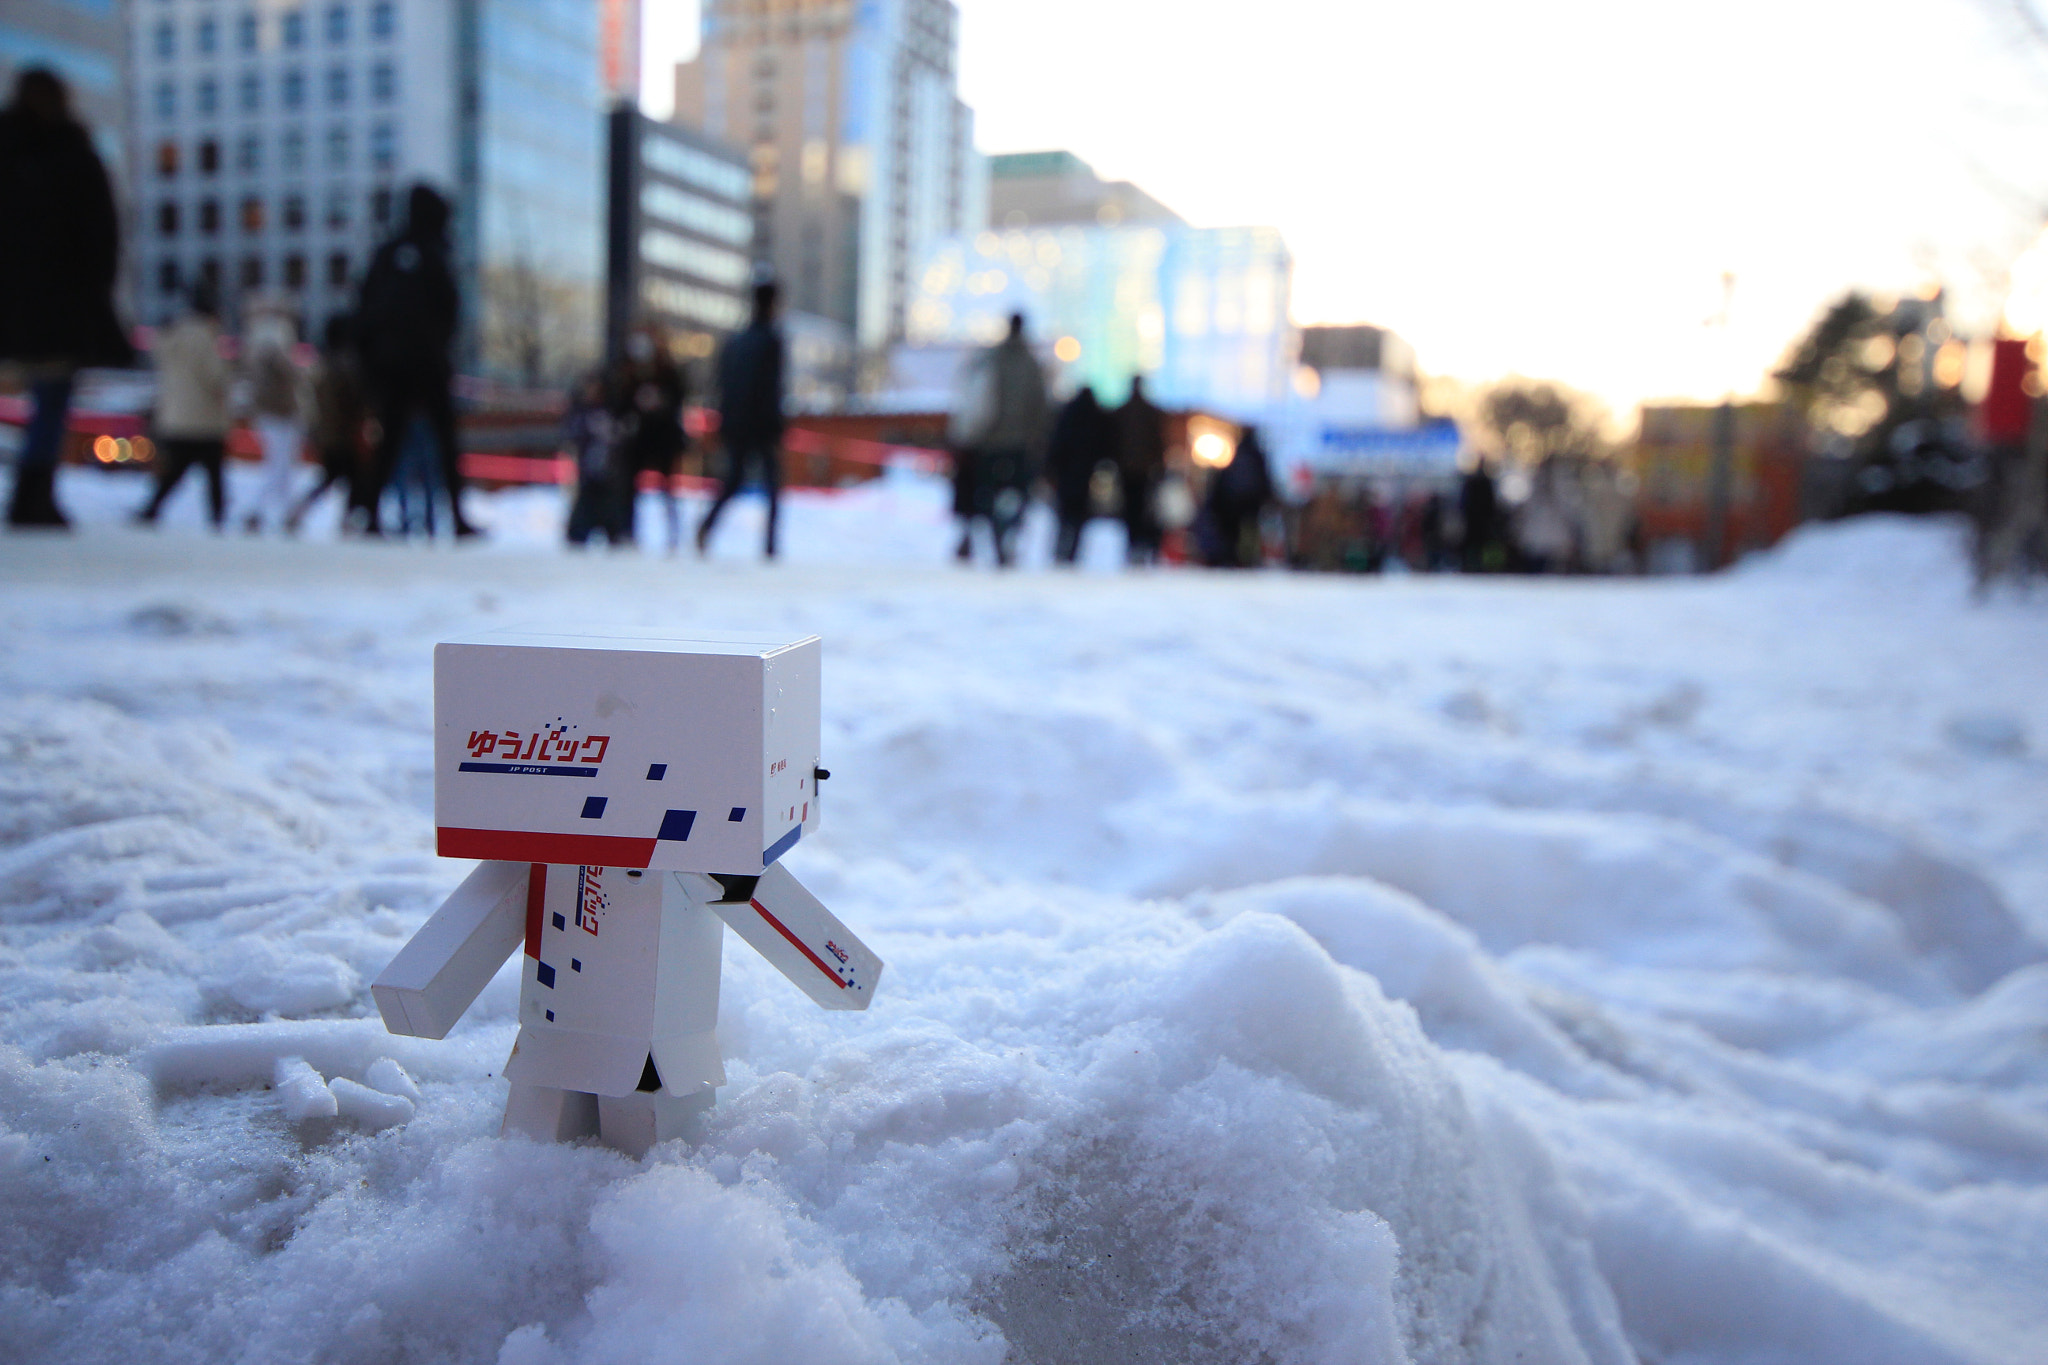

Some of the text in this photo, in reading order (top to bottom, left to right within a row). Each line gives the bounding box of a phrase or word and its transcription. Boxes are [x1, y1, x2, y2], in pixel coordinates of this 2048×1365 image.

[467, 730, 610, 763] ゆうパック
